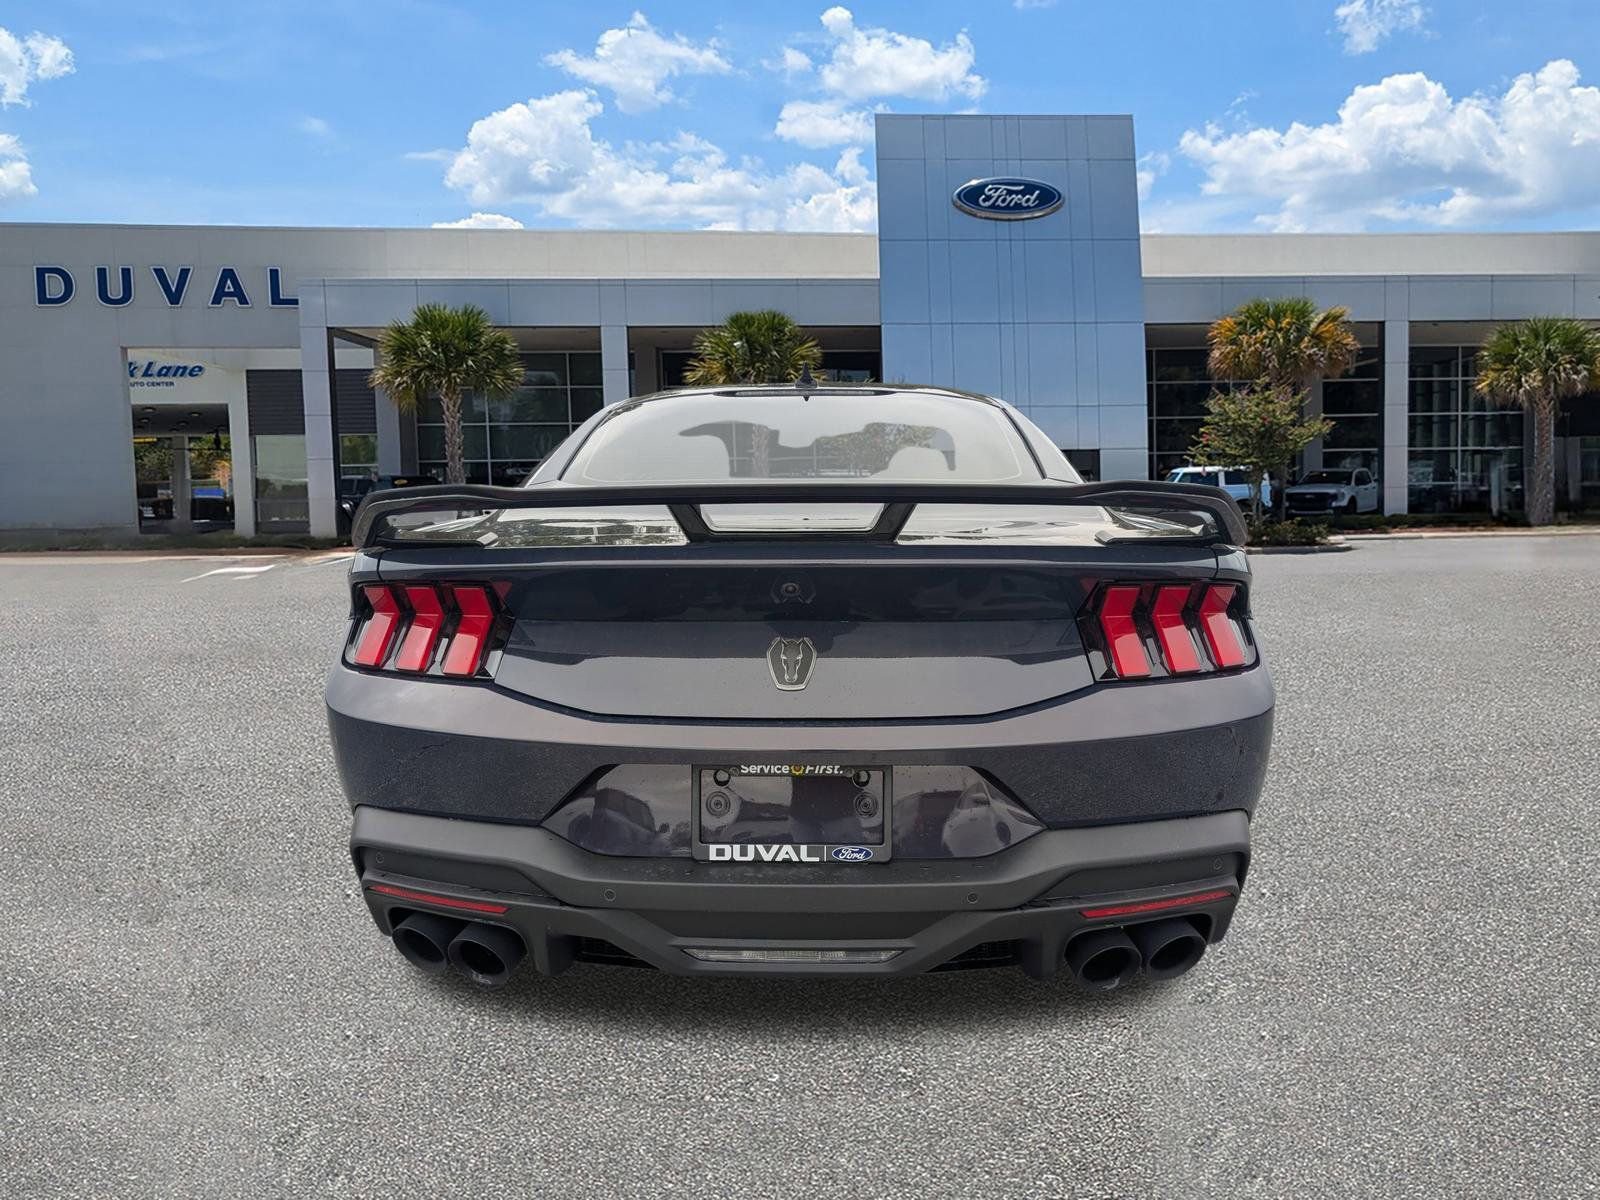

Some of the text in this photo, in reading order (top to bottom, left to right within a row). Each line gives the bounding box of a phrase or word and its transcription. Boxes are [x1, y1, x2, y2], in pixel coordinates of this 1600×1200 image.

[979, 184, 1040, 207] Ford
[34, 265, 299, 307] DUVAL
[141, 361, 204, 378] Lane
[740, 765, 789, 774] Service
[709, 844, 866, 862] DUVAL Ford
